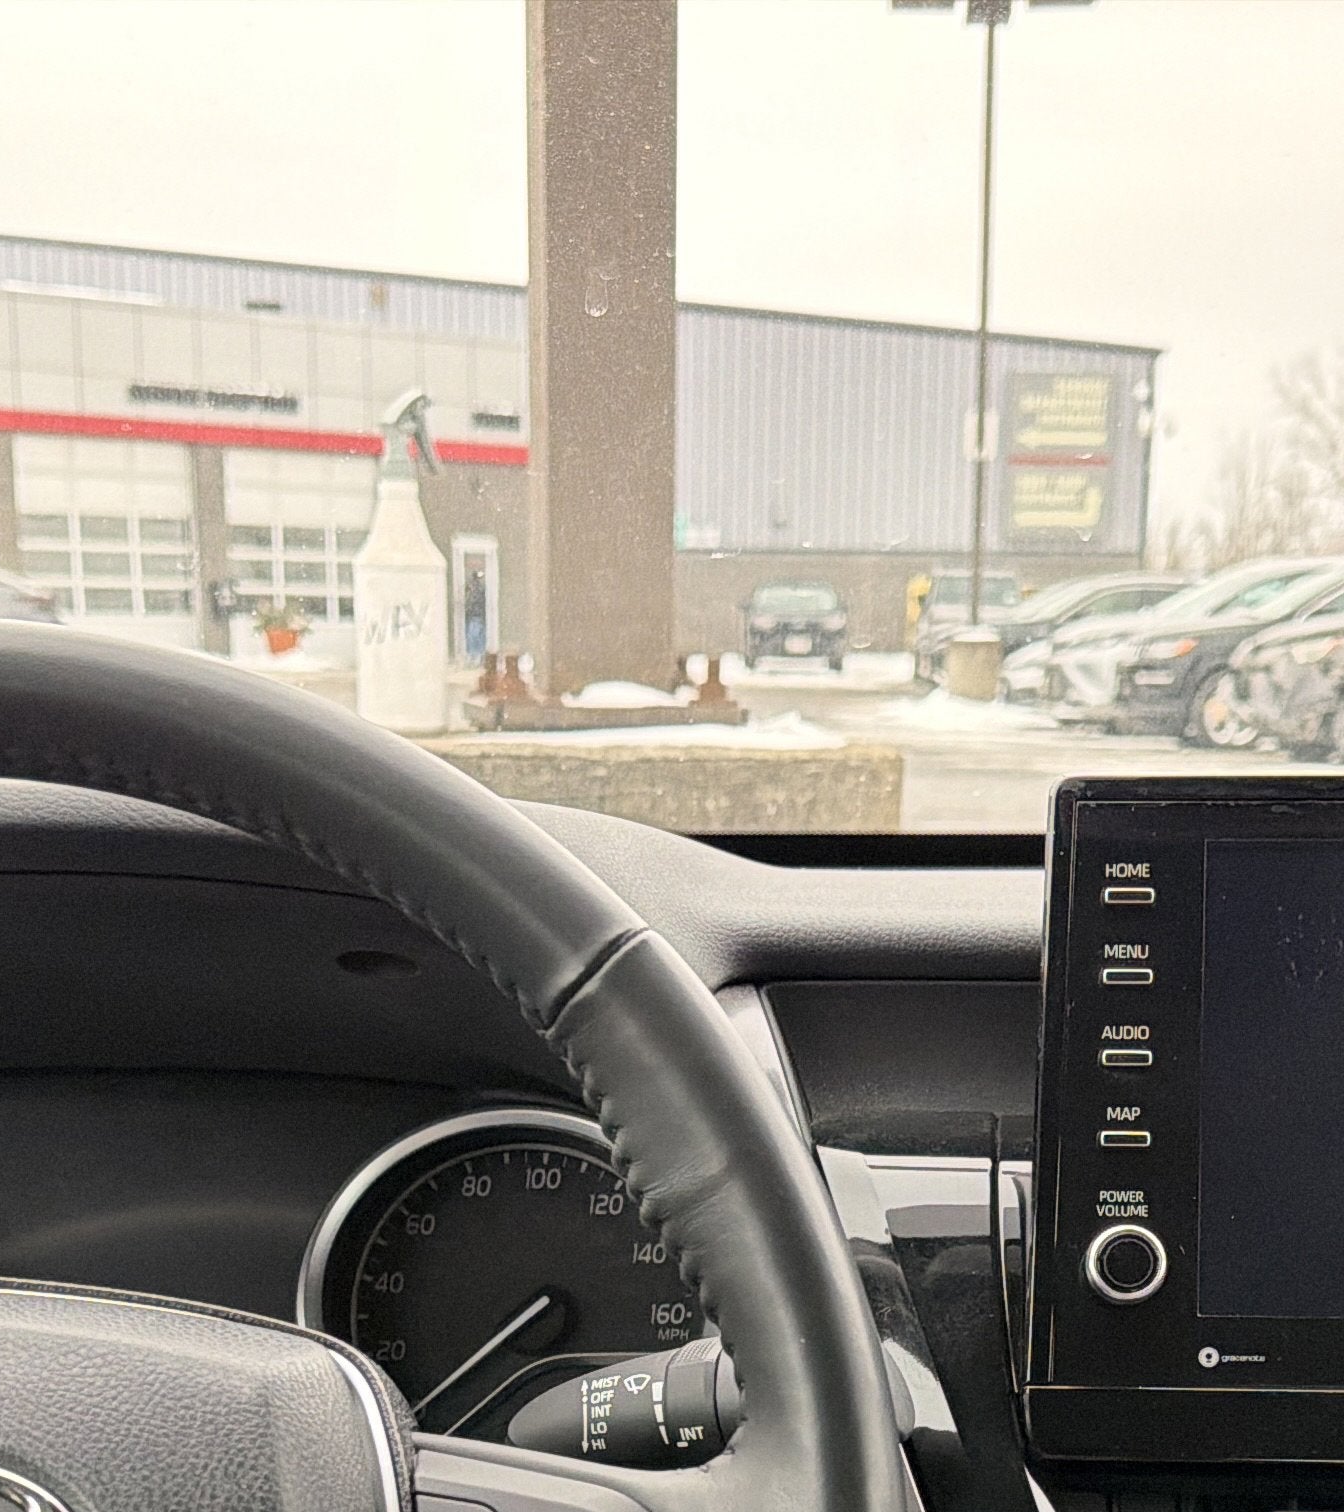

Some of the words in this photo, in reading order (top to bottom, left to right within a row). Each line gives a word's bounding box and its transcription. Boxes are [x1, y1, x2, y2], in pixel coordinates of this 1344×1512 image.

[1106, 863, 1150, 877] HOME
[1105, 944, 1148, 959] MENU
[1102, 1026, 1149, 1039] AUDIO
[1107, 1107, 1140, 1121] MAP
[526, 1168, 561, 1189] 100
[462, 1176, 491, 1196] 80
[1100, 1191, 1144, 1202] POWER
[590, 1193, 623, 1215] 120
[1096, 1205, 1148, 1217] VOLUME
[406, 1214, 435, 1235] 60
[633, 1242, 667, 1264] 140
[375, 1272, 404, 1293] 40
[651, 1303, 684, 1324] 160
[658, 1328, 689, 1340] MPH
[377, 1340, 405, 1361] 20
[591, 1375, 622, 1387] MIST
[591, 1392, 615, 1404] OFF
[591, 1405, 612, 1418] INT
[591, 1422, 607, 1434] LO
[679, 1427, 704, 1441] INT
[591, 1438, 606, 1450] HI
